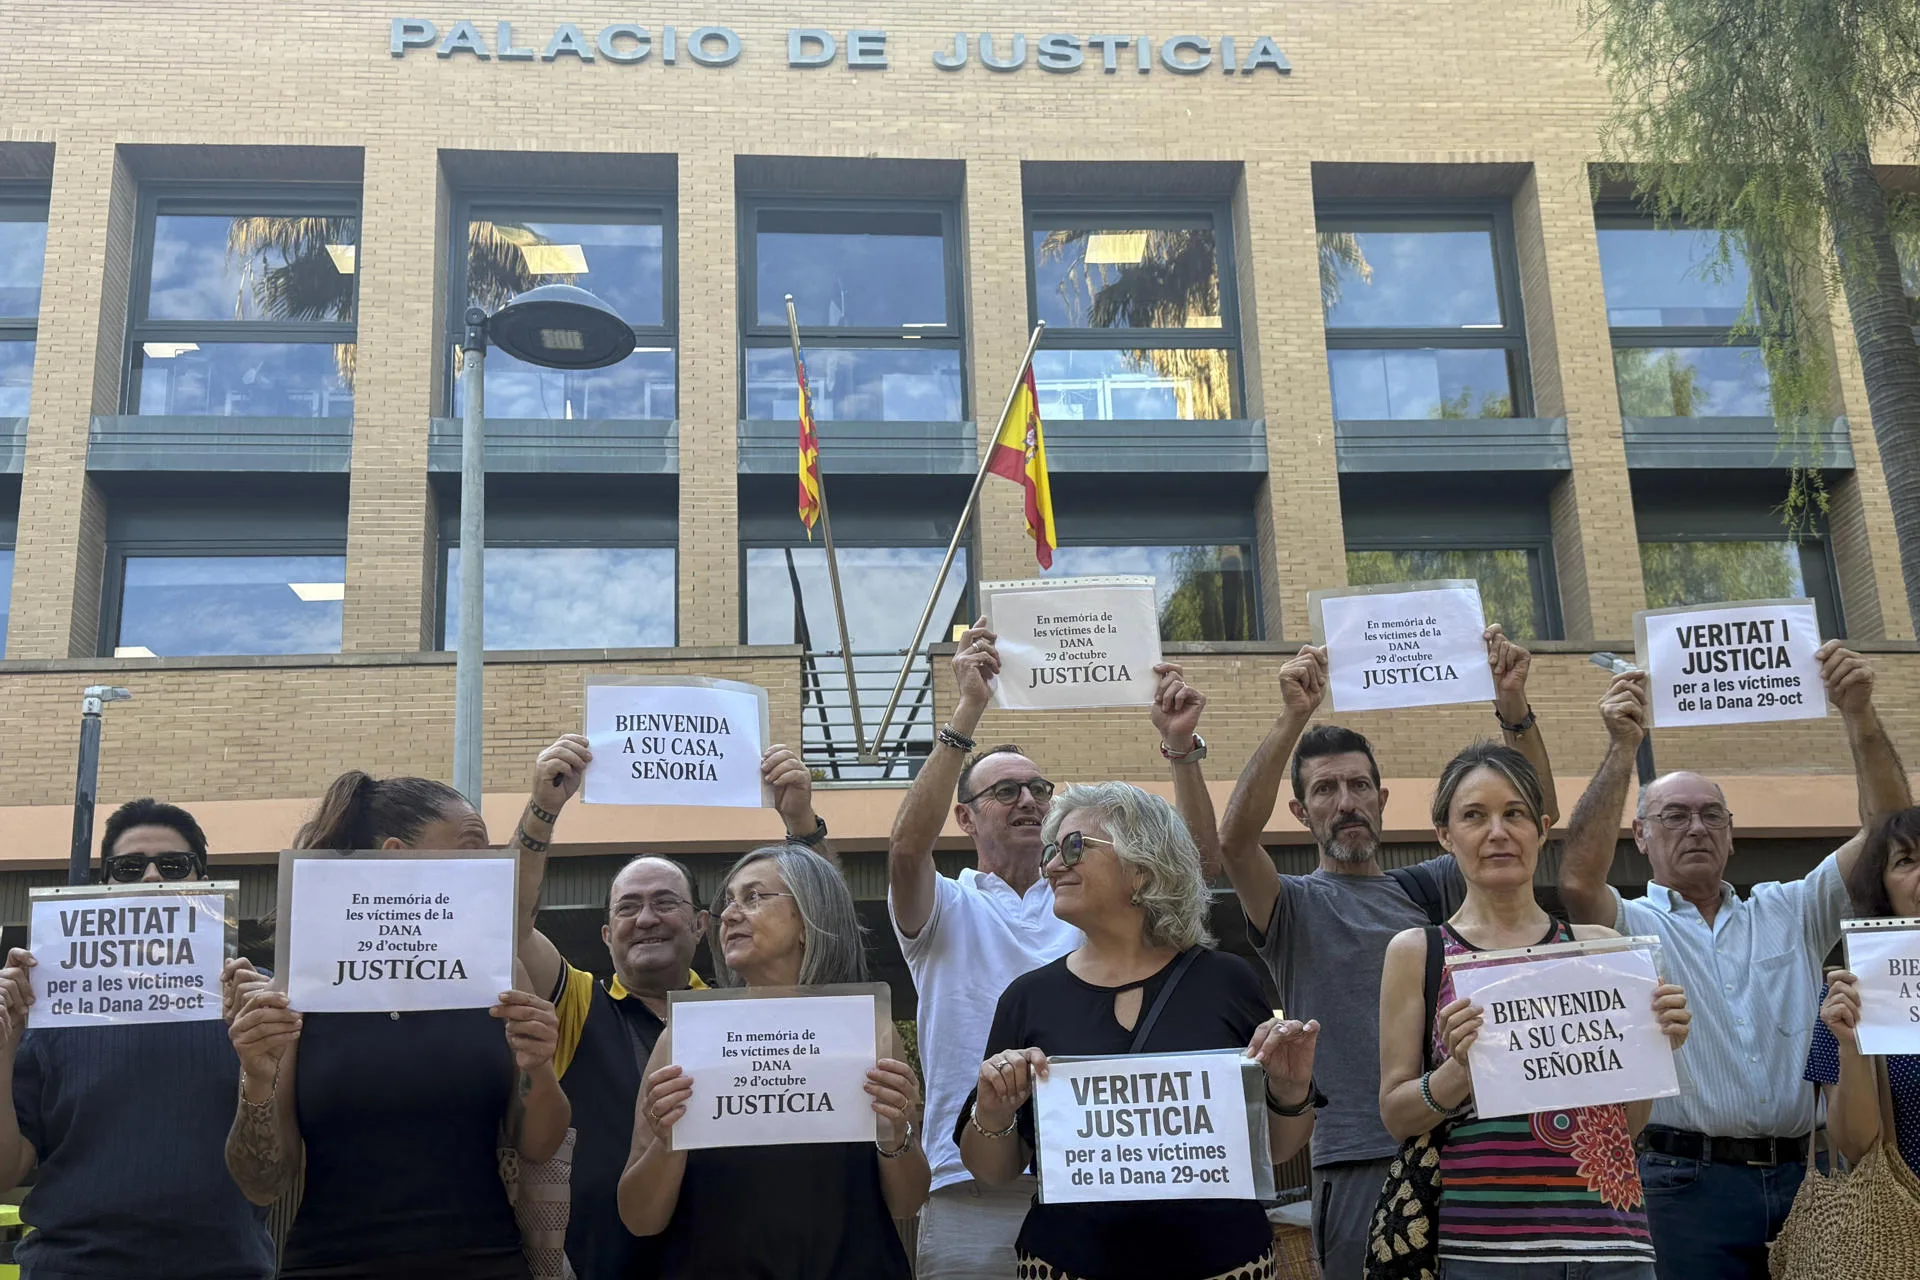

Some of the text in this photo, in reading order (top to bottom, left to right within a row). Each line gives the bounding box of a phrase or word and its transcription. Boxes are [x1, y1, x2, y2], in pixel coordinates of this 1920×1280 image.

[391, 17, 1292, 75] PALACIO DE JUSTICIA
[1037, 612, 1112, 624] En memória de
[1367, 617, 1436, 629] En memória de
[1033, 623, 1117, 637] les víctimes de la
[1364, 632, 1377, 640] les
[1420, 629, 1431, 637] de
[1433, 628, 1441, 636] la
[1676, 619, 1790, 648] VERITAT I
[1060, 638, 1094, 648] DANA
[1389, 641, 1420, 651] DANA
[1045, 650, 1107, 661] 29 d’octubre
[1376, 655, 1386, 664] 29
[1682, 646, 1792, 675] JUSTICIA
[1029, 662, 1132, 688] JUSTÍCIA
[1362, 663, 1459, 689] JUSTÍCIA
[1672, 675, 1801, 697] per a les víctimes
[1678, 692, 1803, 711] de la Dana 29-oct
[616, 714, 731, 735] BIENVENIDA
[622, 736, 724, 759] A SU CASA,
[631, 759, 718, 781] SEÑORÍA
[351, 893, 450, 905] En memória de
[60, 906, 196, 937] VERITAT I
[346, 909, 454, 921] les víctimes de la
[379, 925, 422, 936] DANA
[60, 938, 195, 969] JUSTICIA
[358, 940, 438, 952] 29 d’octubre
[332, 955, 468, 986] JUSTÍCIA
[48, 972, 204, 997] per a les víctimes
[1899, 982, 1911, 998] A
[52, 994, 204, 1015] de la Dana 29-oct
[1491, 988, 1626, 1024] BIENVENIDA
[727, 1029, 815, 1042] En memória de
[1509, 1018, 1624, 1051] A SU CASA,
[722, 1044, 820, 1057] les víctimes de la
[752, 1060, 792, 1072] DANA
[1523, 1046, 1623, 1081] SEÑORÍA
[734, 1075, 806, 1087] 29 d’octubre
[1070, 1071, 1211, 1106] VERITAT I
[712, 1089, 835, 1120] JUSTÍCIA
[1077, 1105, 1214, 1138] JUSTICIA
[1065, 1142, 1227, 1167] per a les víctimes
[1071, 1166, 1230, 1185] de la Dana 29-oct
